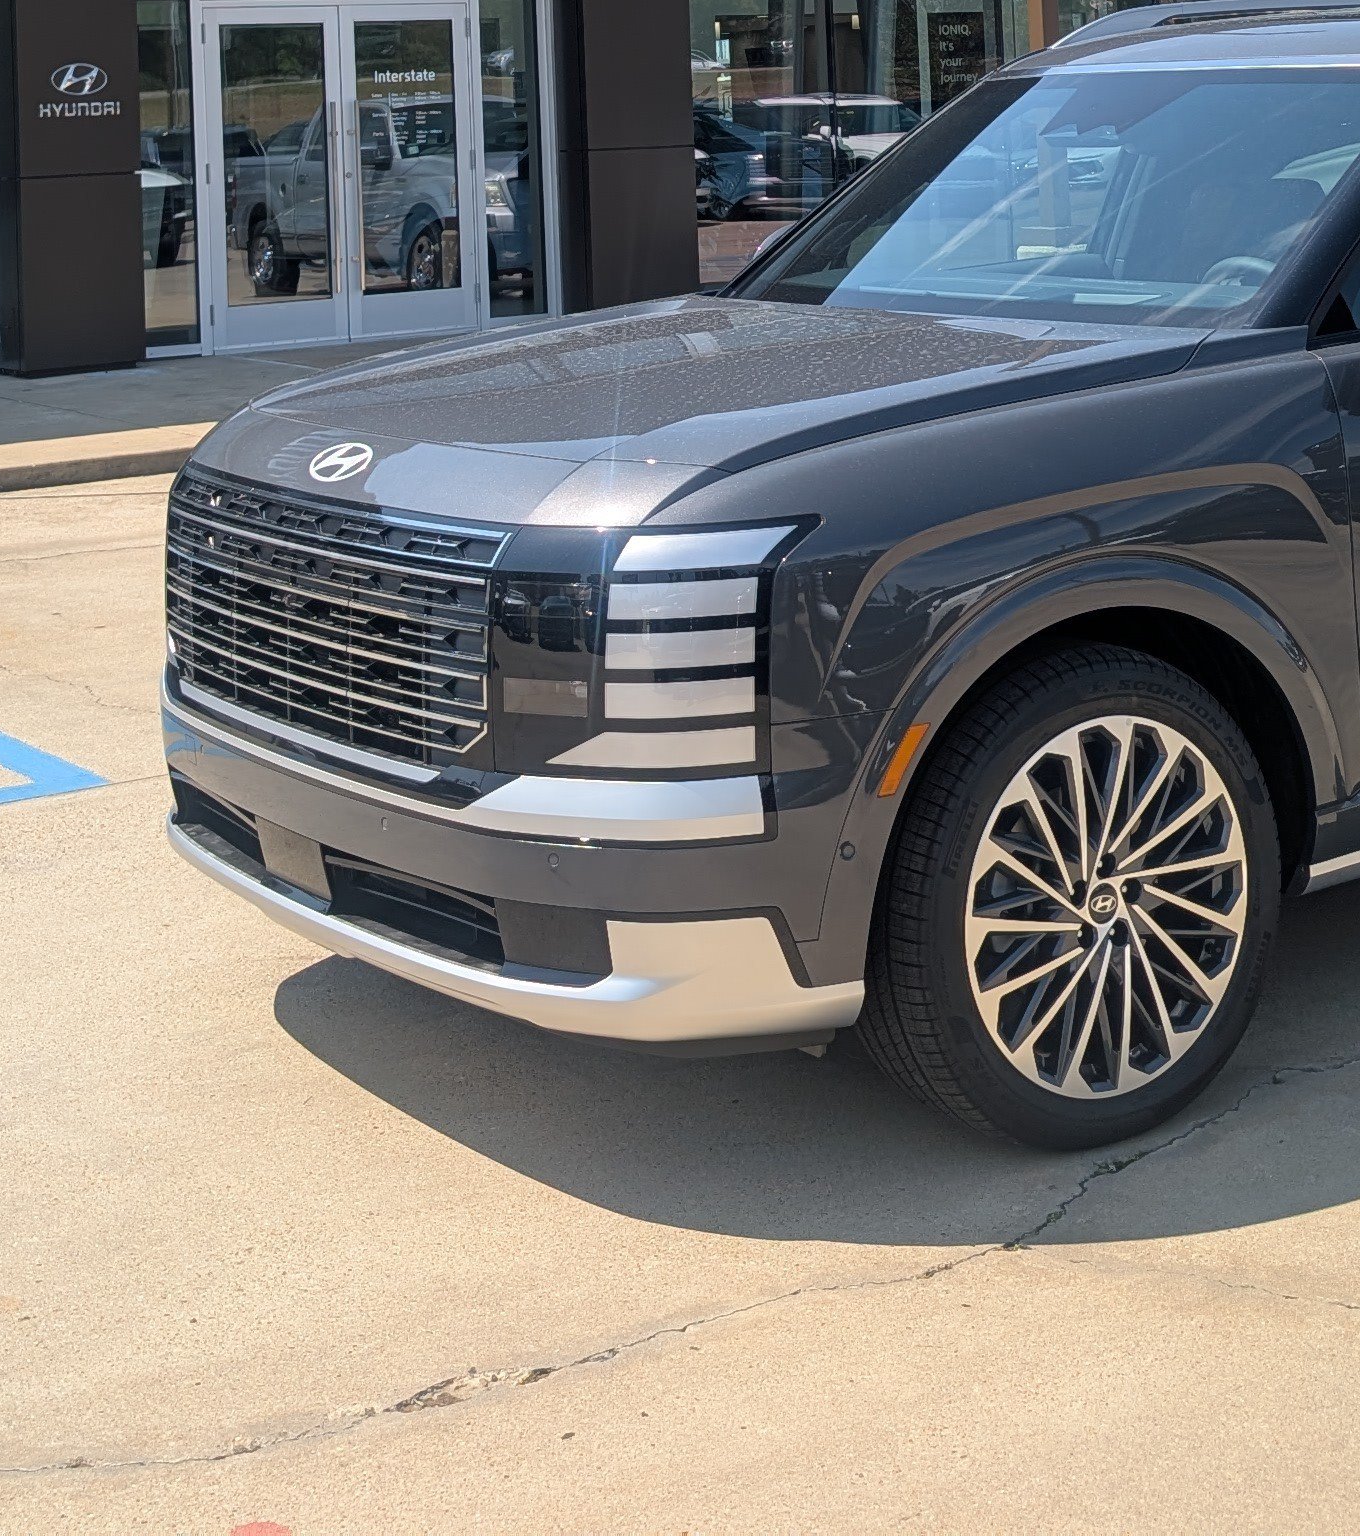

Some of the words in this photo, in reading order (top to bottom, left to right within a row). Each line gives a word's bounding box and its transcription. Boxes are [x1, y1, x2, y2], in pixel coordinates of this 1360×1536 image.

[939, 57, 964, 69] your
[374, 68, 436, 83] Interstate
[39, 101, 120, 118] HYUNDAI
[1117, 679, 1223, 731] SCORPION
